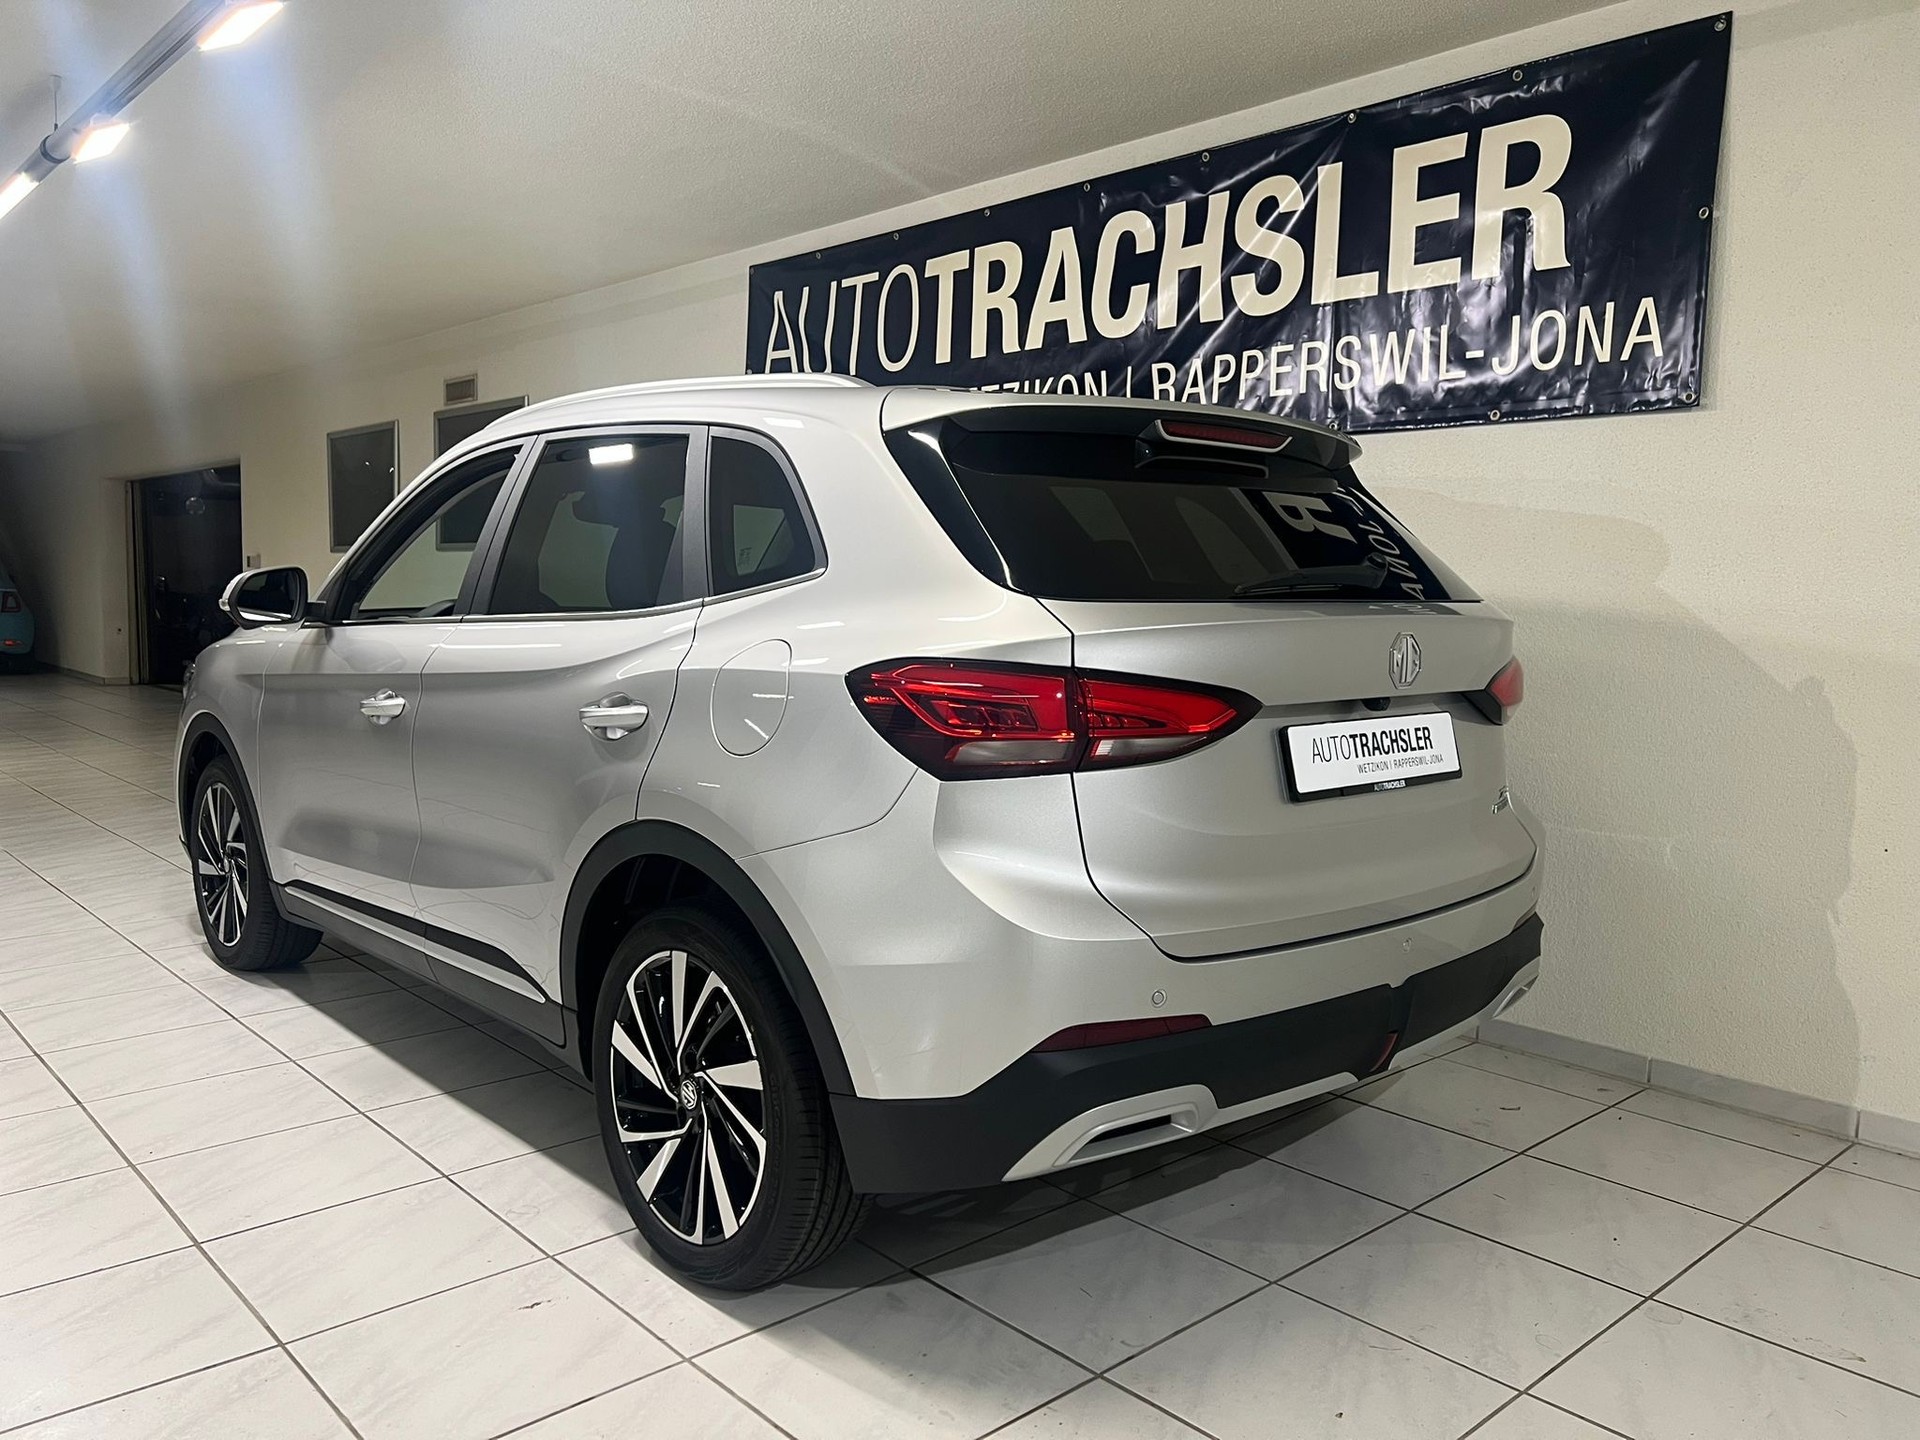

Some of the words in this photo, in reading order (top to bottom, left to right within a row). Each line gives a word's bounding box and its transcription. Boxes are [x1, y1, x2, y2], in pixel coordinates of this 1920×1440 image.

[764, 113, 1573, 375] AUTOTRACHSLER
[1151, 296, 1665, 405] RAPPERSWIL-JONA
[1312, 726, 1434, 764] AUTOTRACHSLER
[1358, 760, 1389, 774] WETZIKON
[1393, 754, 1444, 769] RAPPERSWIL-JONA
